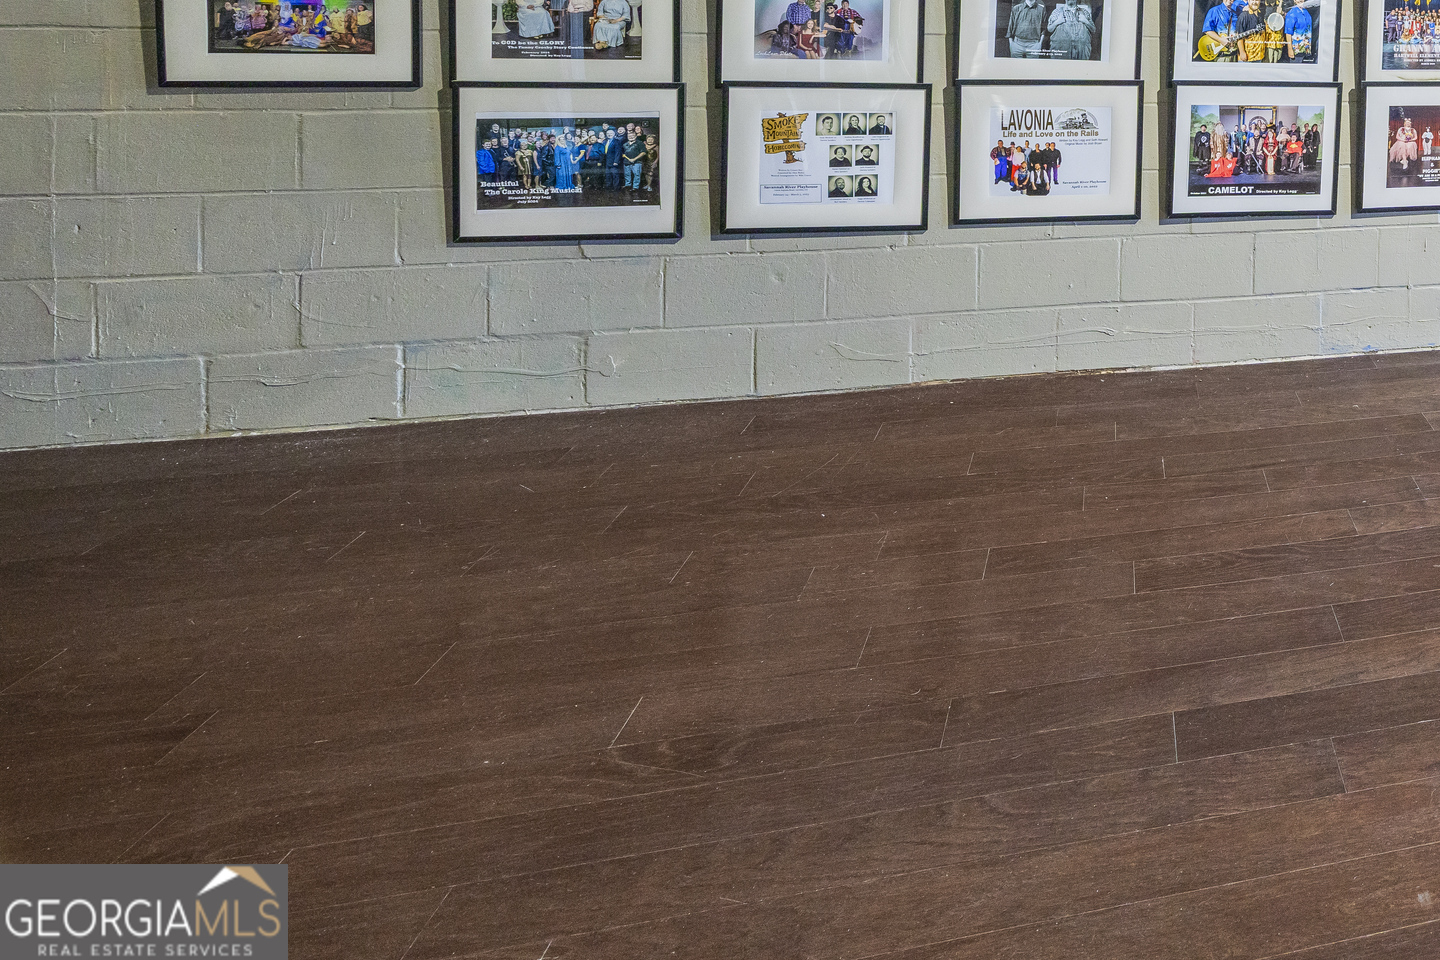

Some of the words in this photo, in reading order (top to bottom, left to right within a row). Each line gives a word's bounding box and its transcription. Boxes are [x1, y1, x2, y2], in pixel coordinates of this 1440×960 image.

[1001, 109, 1054, 130] LAVONIA
[480, 180, 519, 188] Beautiful
[1208, 186, 1254, 194] CAMELOT
